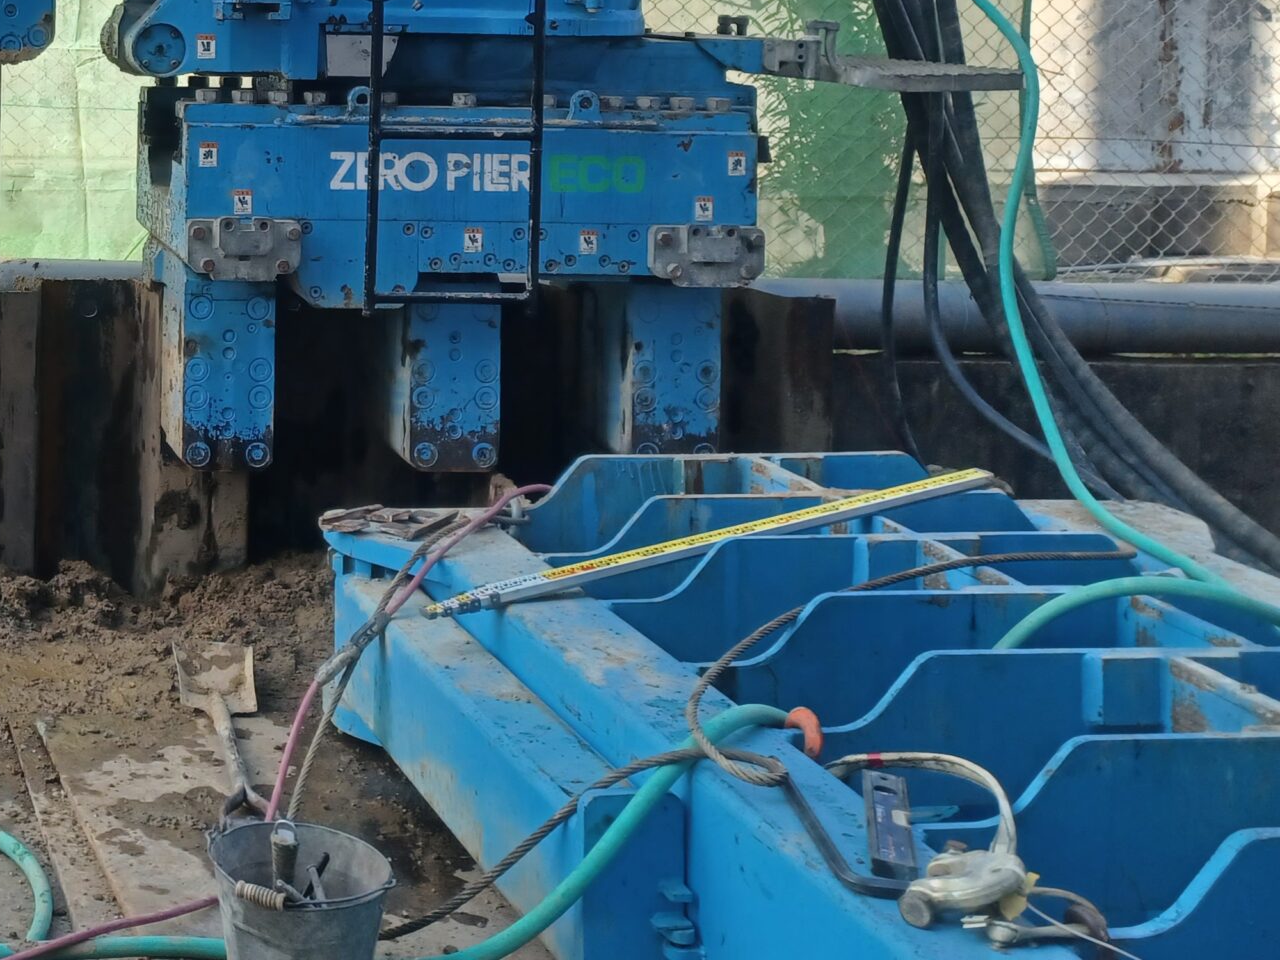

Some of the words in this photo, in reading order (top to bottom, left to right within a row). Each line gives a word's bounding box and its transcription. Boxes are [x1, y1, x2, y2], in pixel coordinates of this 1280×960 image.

[329, 151, 438, 191] ZERO
[446, 152, 531, 192] PILER
[549, 154, 646, 194] ECO
